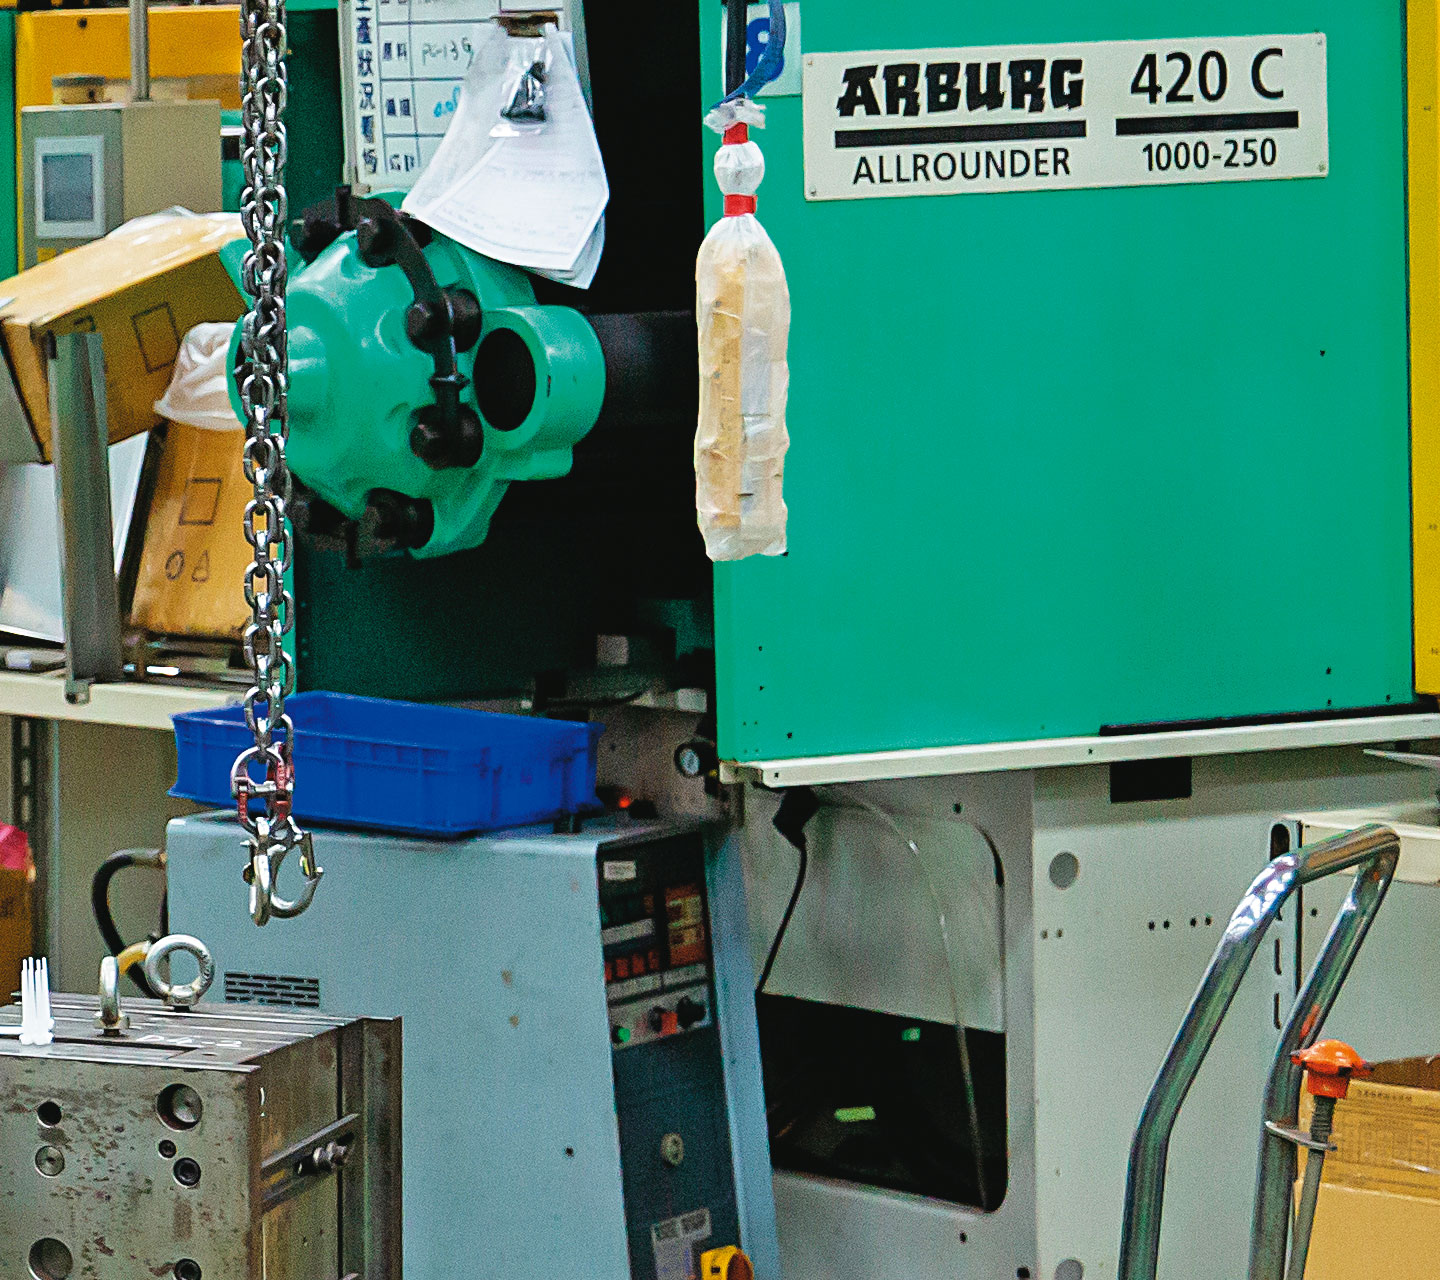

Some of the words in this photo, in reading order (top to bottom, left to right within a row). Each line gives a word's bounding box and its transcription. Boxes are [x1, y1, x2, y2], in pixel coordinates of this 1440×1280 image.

[836, 59, 1087, 117] ARBURG
[1130, 50, 1228, 105] 420
[1251, 48, 1284, 101] C
[852, 147, 1071, 185] ALLROUNDER
[1142, 138, 1277, 173] 1000-250
